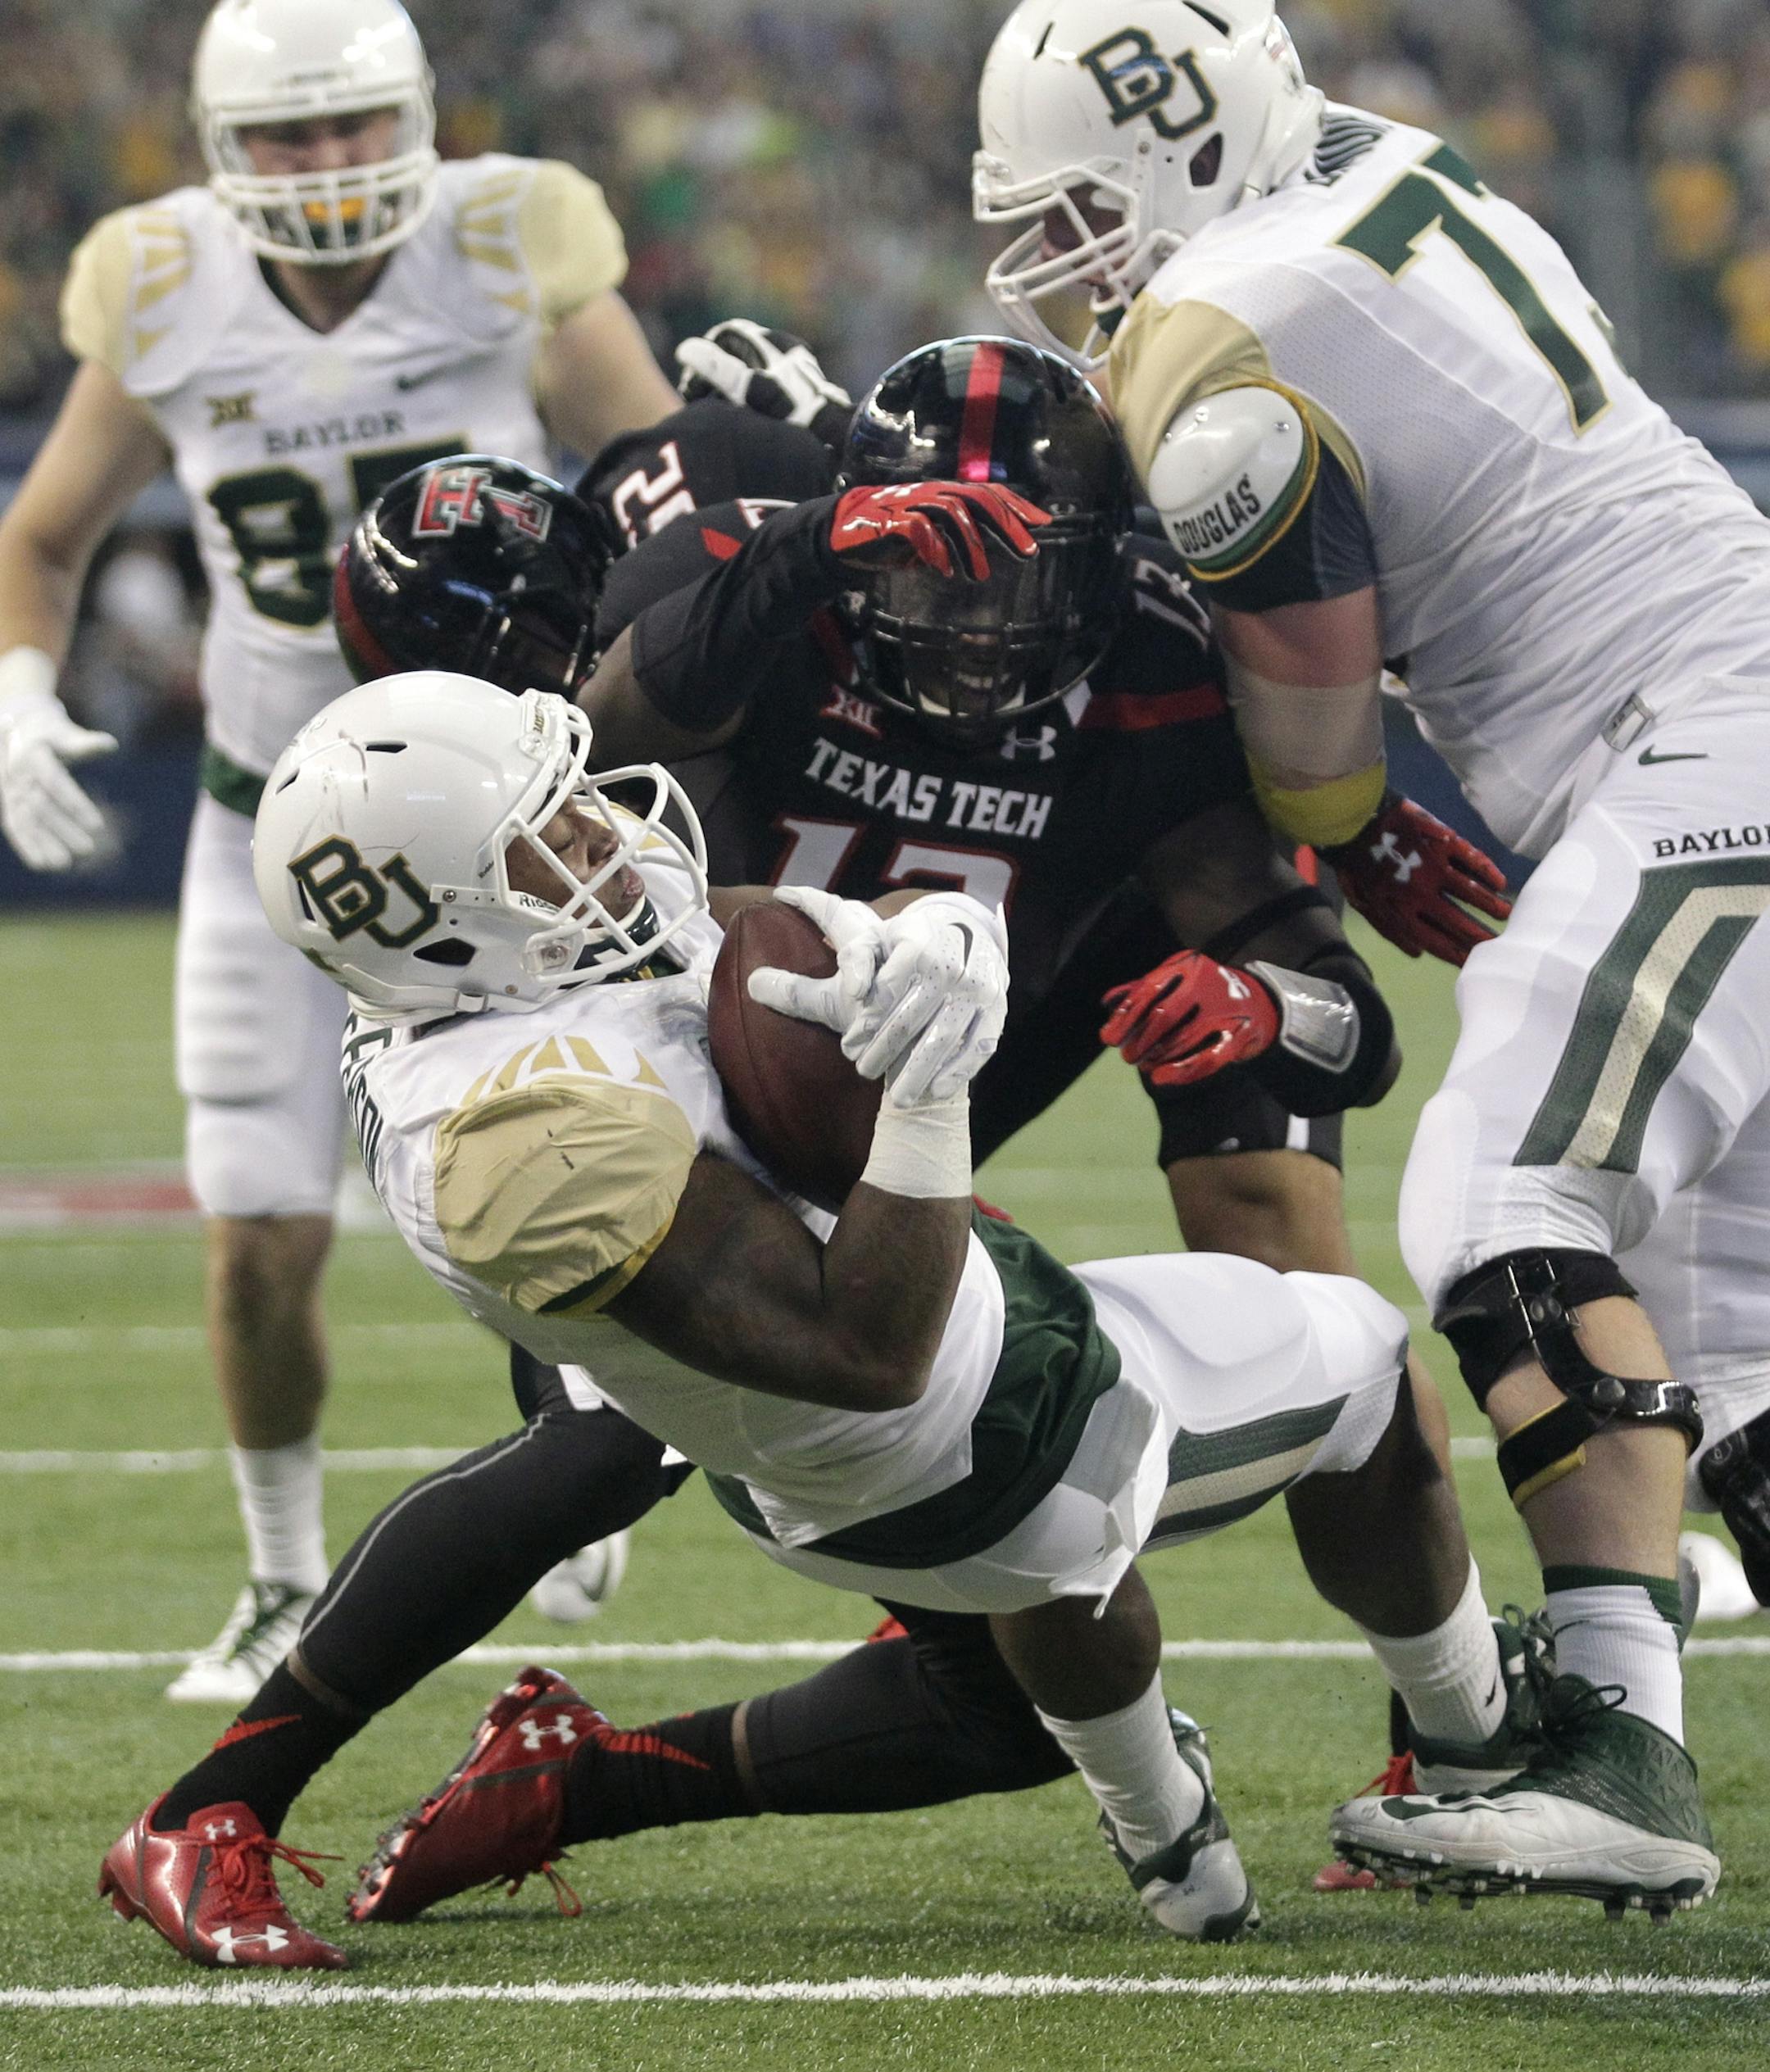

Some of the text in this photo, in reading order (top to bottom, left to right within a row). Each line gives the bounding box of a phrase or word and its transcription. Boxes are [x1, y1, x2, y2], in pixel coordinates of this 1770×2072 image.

[1078, 25, 1219, 140] BU
[1325, 139, 1618, 440] 7
[263, 410, 406, 456] BAYLOR
[1173, 477, 1262, 555] DOUGLAS
[804, 736, 1054, 841] TEXAS TECH
[287, 832, 442, 949] BU
